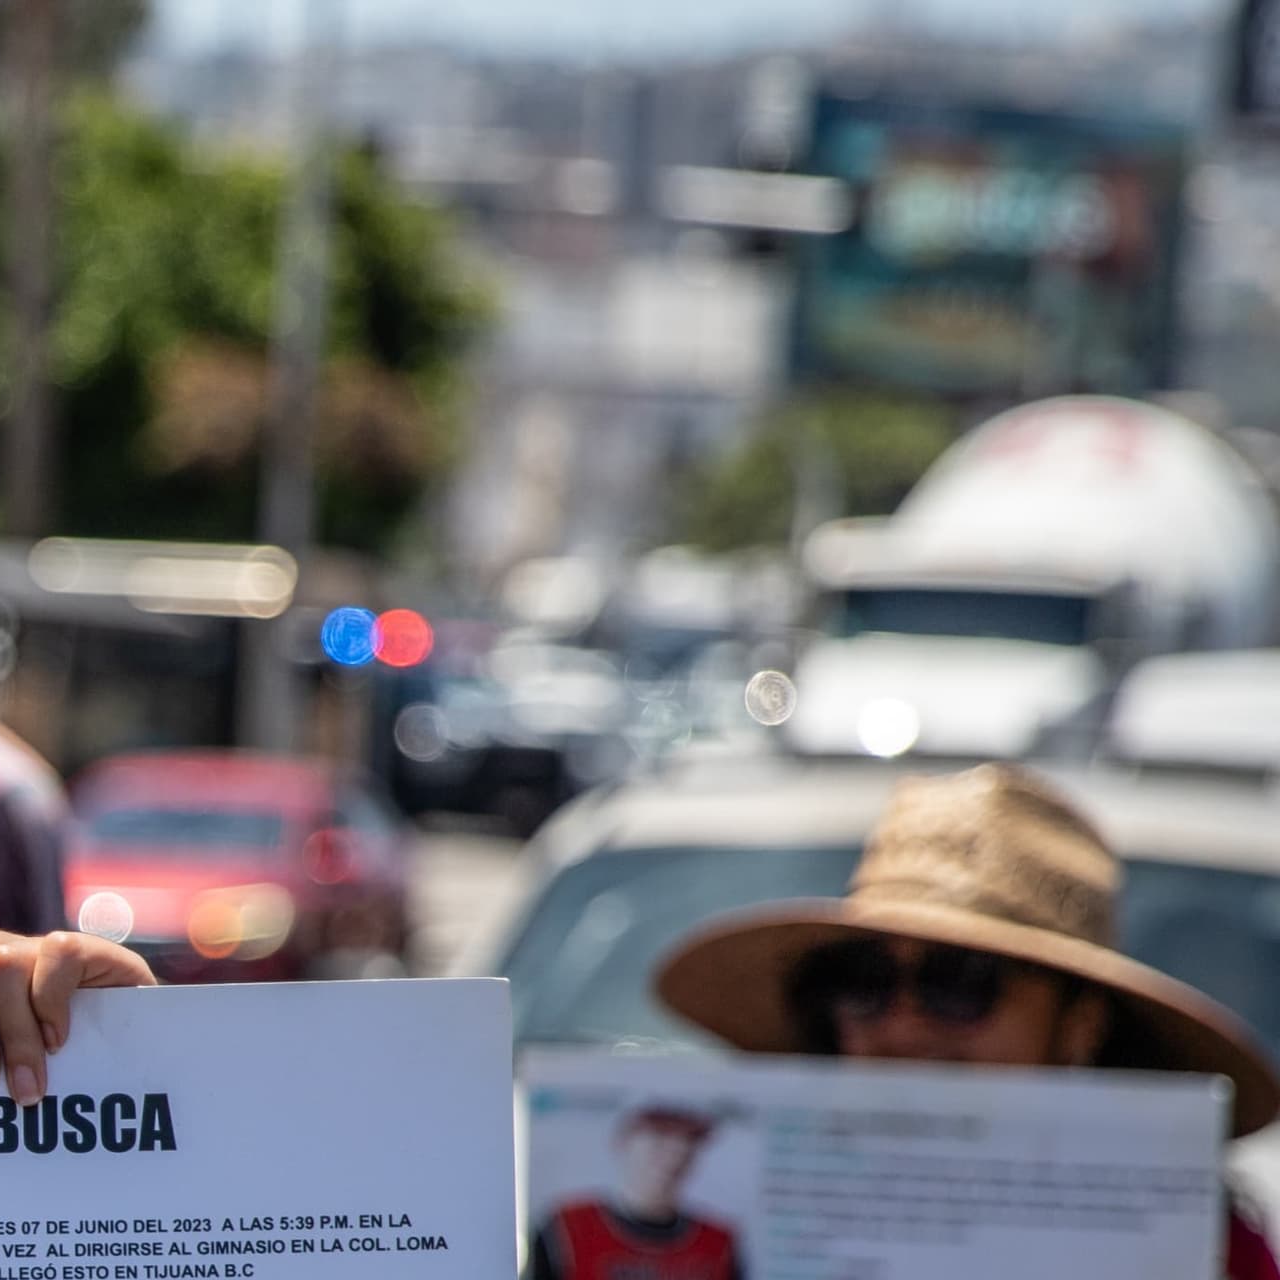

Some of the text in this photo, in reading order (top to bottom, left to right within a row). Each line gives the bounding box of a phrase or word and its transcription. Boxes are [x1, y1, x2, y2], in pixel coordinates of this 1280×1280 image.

[20, 1220, 40, 1235] 07
[45, 1219, 70, 1234] DE
[73, 1218, 128, 1234] JUNIO
[132, 1218, 168, 1233] DEL
[172, 1217, 212, 1233] 2023
[220, 1217, 234, 1232] A
[239, 1216, 274, 1231] LAS
[279, 1215, 315, 1230] 5:39
[319, 1214, 353, 1229] P.M.
[358, 1213, 383, 1229] EN
[388, 1213, 412, 1228] LA
